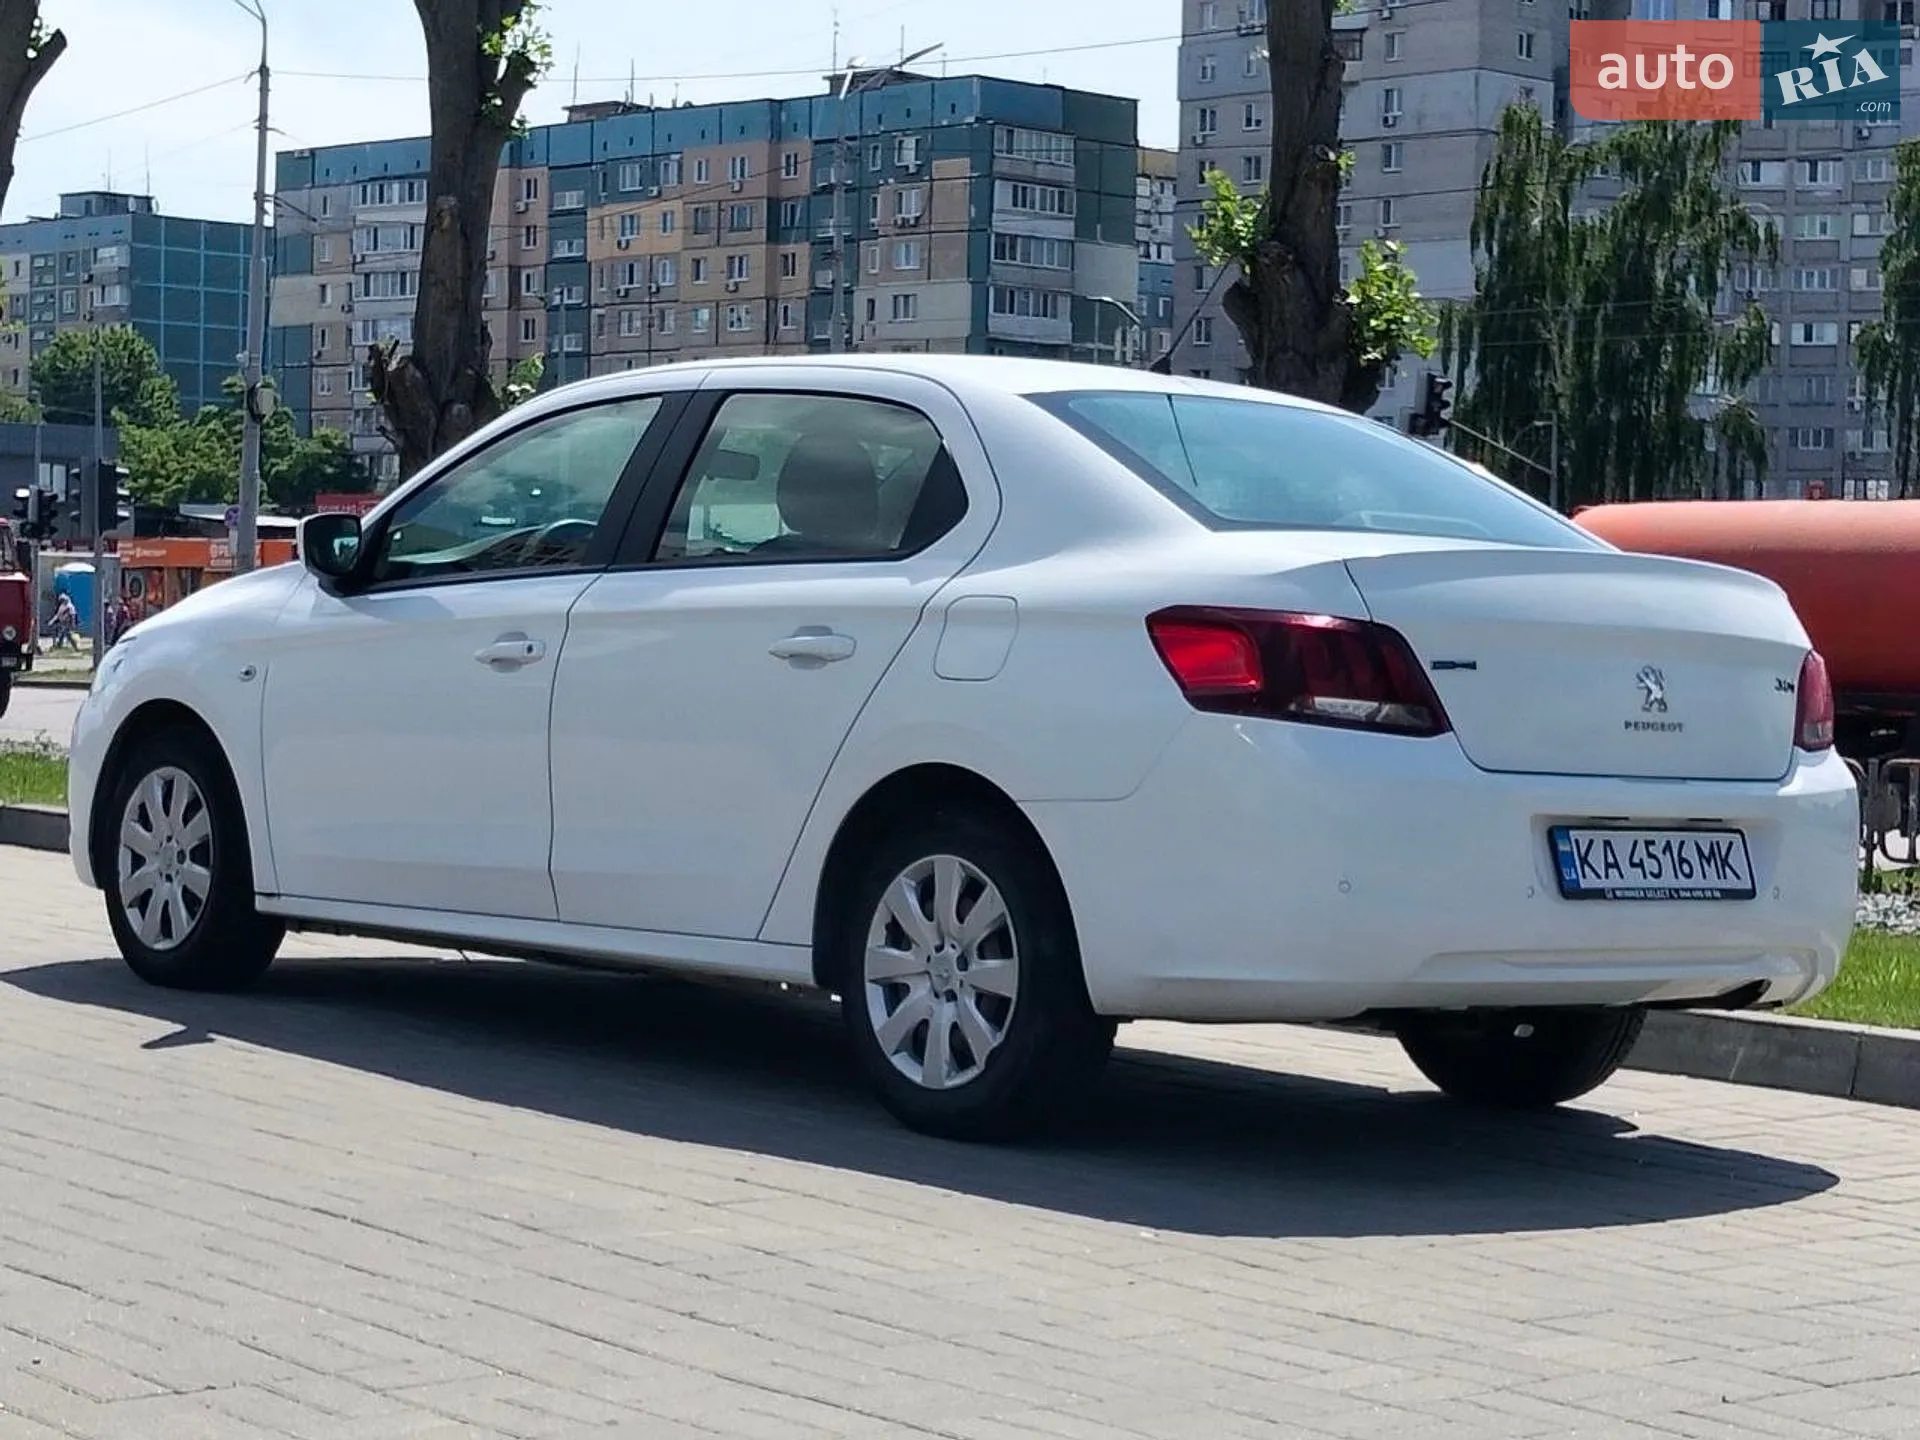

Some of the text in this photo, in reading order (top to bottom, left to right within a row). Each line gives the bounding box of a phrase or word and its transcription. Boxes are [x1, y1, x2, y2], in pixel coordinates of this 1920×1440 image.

[1624, 720, 1683, 732] PEUGEOT
[1574, 838, 1741, 880] KA 4516 MK
